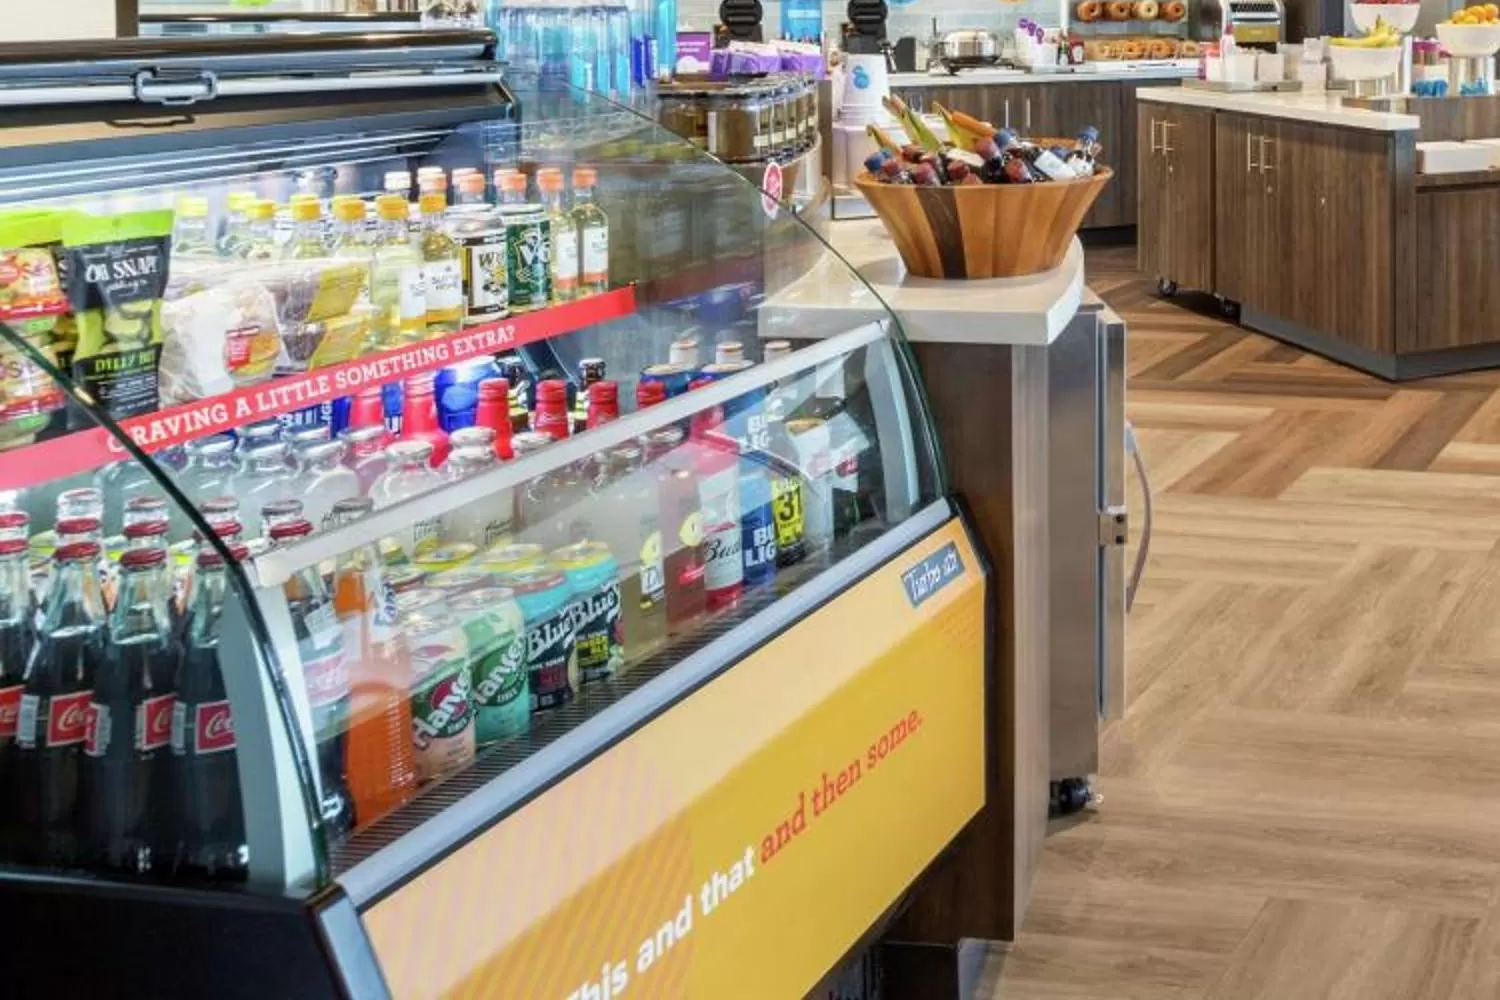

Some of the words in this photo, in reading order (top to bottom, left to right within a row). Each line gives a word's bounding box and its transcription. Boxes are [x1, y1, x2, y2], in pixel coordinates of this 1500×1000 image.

[107, 401, 229, 453] CRAVING
[236, 398, 254, 418] A
[255, 374, 332, 413] LITTLE
[334, 342, 449, 389] SOMETHING
[451, 325, 516, 354] EXTRA?
[745, 543, 777, 567] LIG
[753, 525, 775, 546] BU
[637, 894, 694, 974] and
[700, 845, 755, 917] that
[760, 792, 806, 865] and
[811, 757, 862, 818] then
[867, 708, 925, 770] some.
